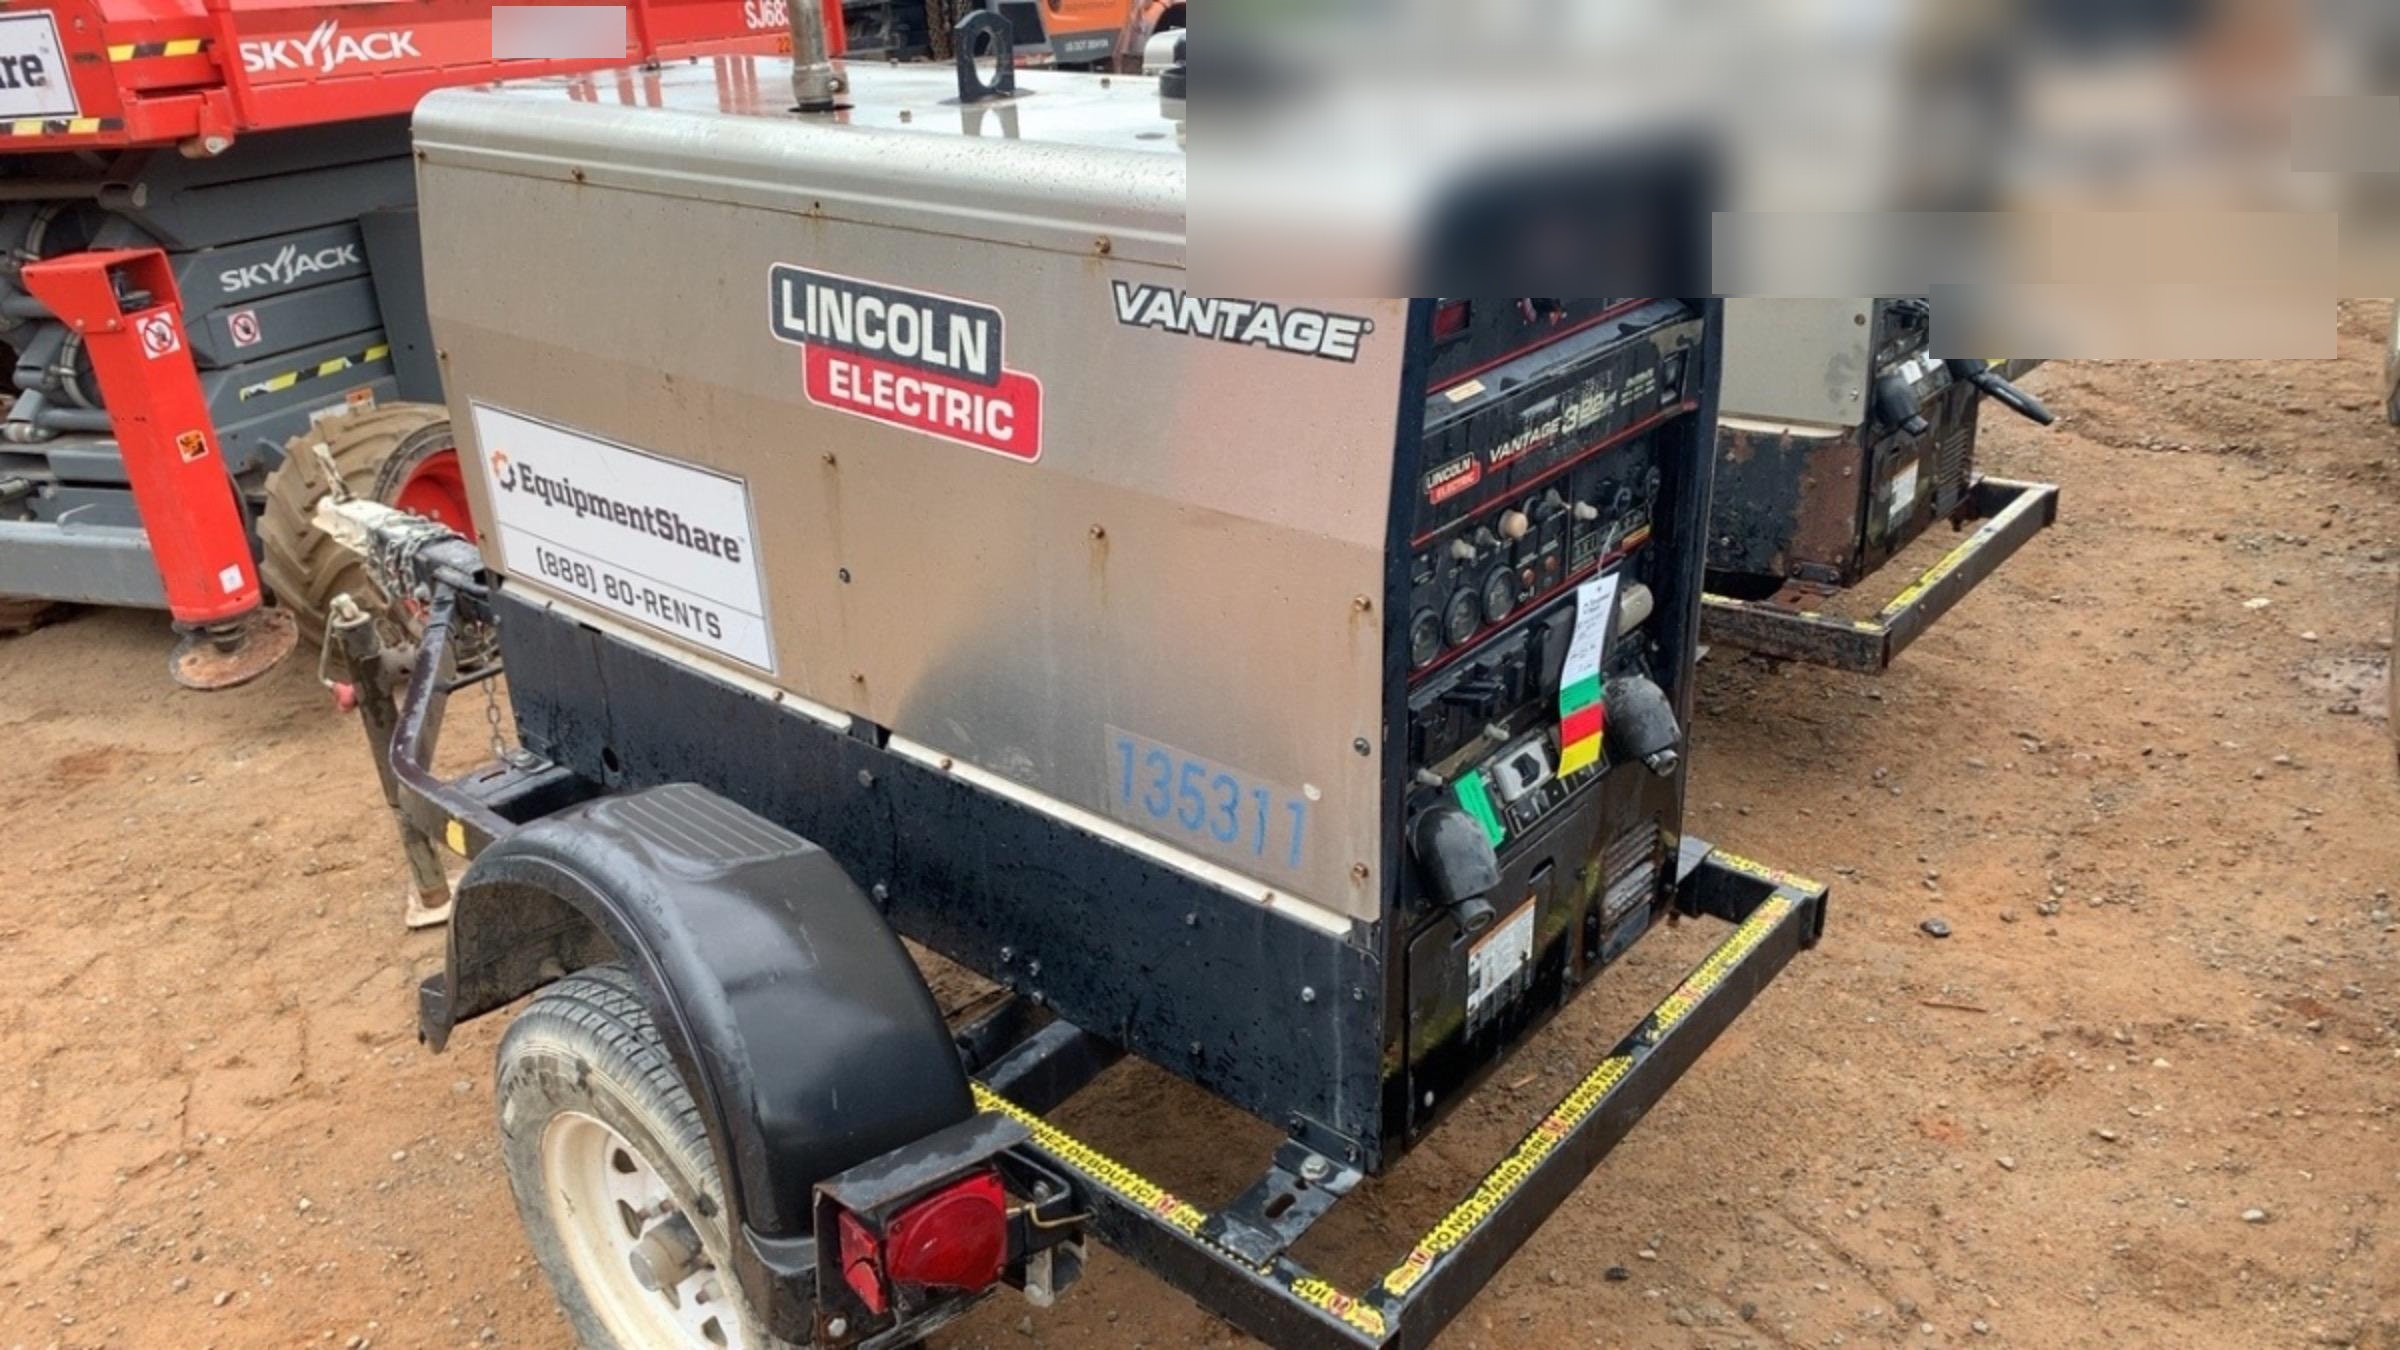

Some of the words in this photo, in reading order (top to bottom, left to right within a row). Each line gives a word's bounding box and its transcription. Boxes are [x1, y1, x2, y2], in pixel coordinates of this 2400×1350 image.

[0, 54, 45, 88] re
[239, 20, 420, 73] SKYJACK
[220, 244, 360, 294] SKYJACK
[780, 278, 988, 375] LINCOLN
[1112, 280, 1361, 363] VANTAGE
[829, 358, 1014, 442] ELECTRIC
[1489, 416, 1561, 463] VANTAGE
[516, 461, 741, 563] EquipmentShare
[1425, 457, 1472, 489] LINCOLN
[535, 545, 597, 594] (888)
[605, 573, 723, 641] 80-RENTS
[1117, 736, 1307, 870] 135311
[1066, 1142, 1134, 1191] DEBOUT
[1426, 1230, 1451, 1252] DO
[1450, 1204, 1478, 1231] NOT
[1476, 1163, 1521, 1206] STAND
[1519, 1133, 1552, 1165] HERE
